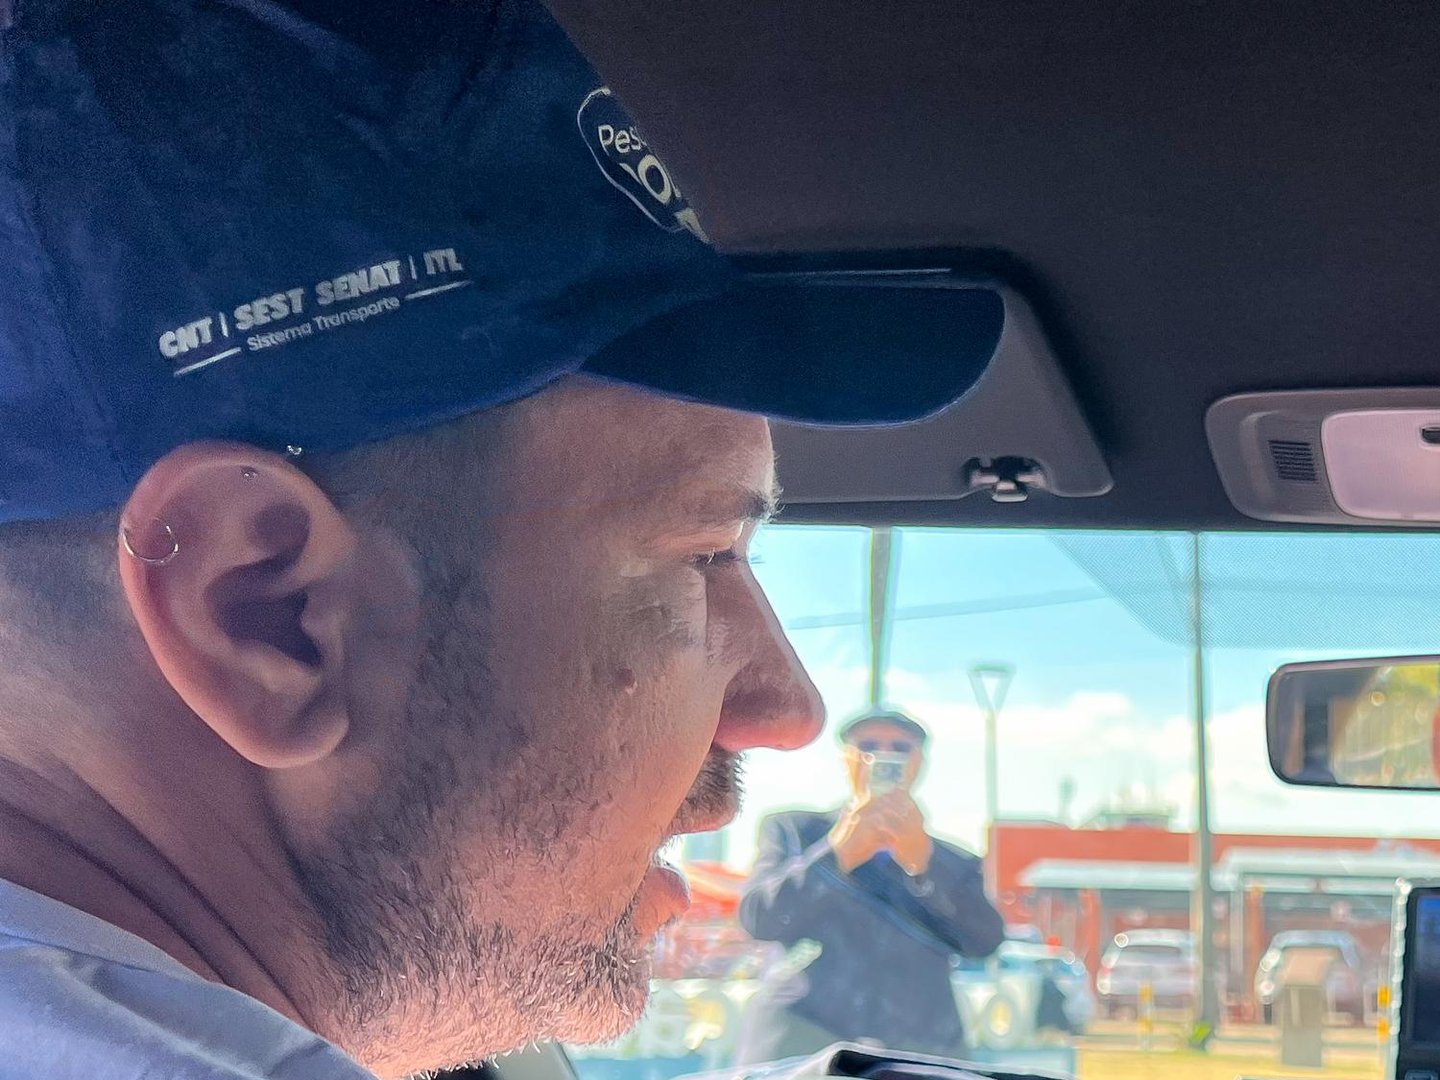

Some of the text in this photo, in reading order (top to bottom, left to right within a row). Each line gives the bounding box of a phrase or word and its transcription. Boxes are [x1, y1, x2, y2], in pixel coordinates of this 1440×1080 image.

[159, 248, 463, 357] CNT SEST SENAT ITL
[247, 296, 400, 351] Sistema Transporte
